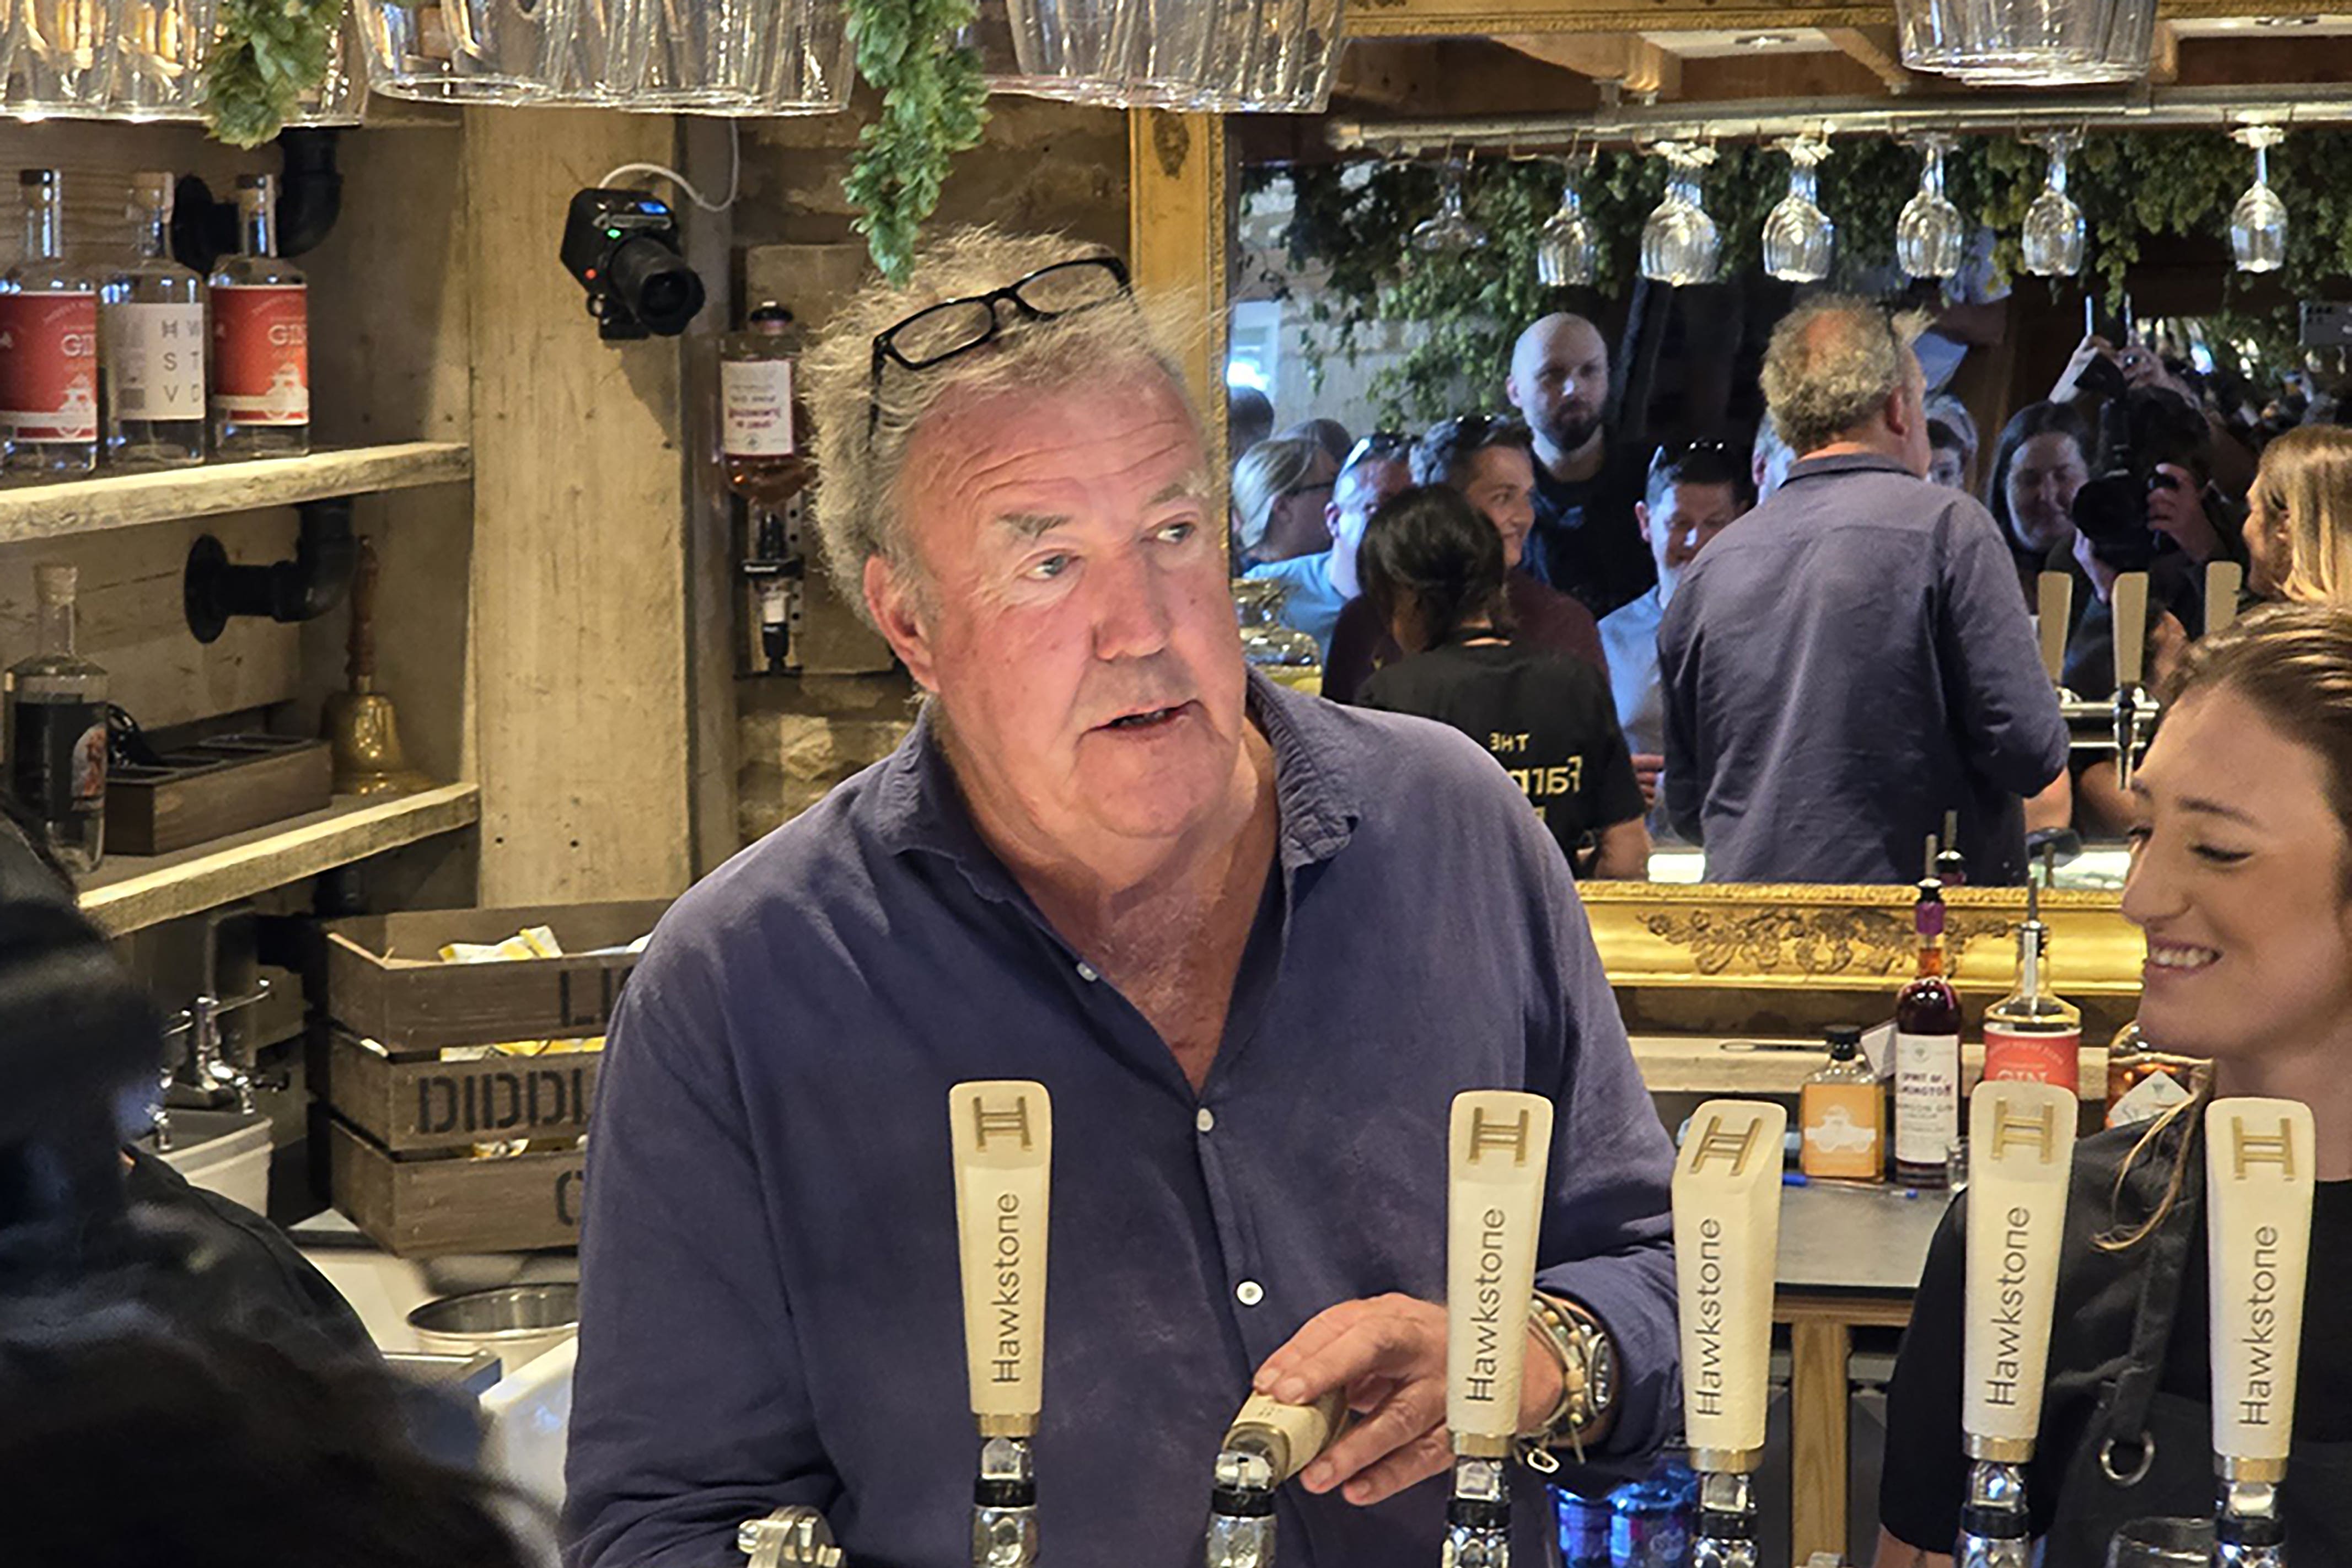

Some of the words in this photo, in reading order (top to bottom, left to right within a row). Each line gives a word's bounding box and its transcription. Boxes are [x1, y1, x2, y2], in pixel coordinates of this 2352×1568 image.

[991, 1193, 1021, 1383] Hawkstone
[1465, 1208, 1506, 1403] Hawkstone
[1695, 1217, 1722, 1417] Hawkstone
[1985, 1206, 2031, 1406] Hawkstone
[2239, 1226, 2279, 1426] Hawkstone
